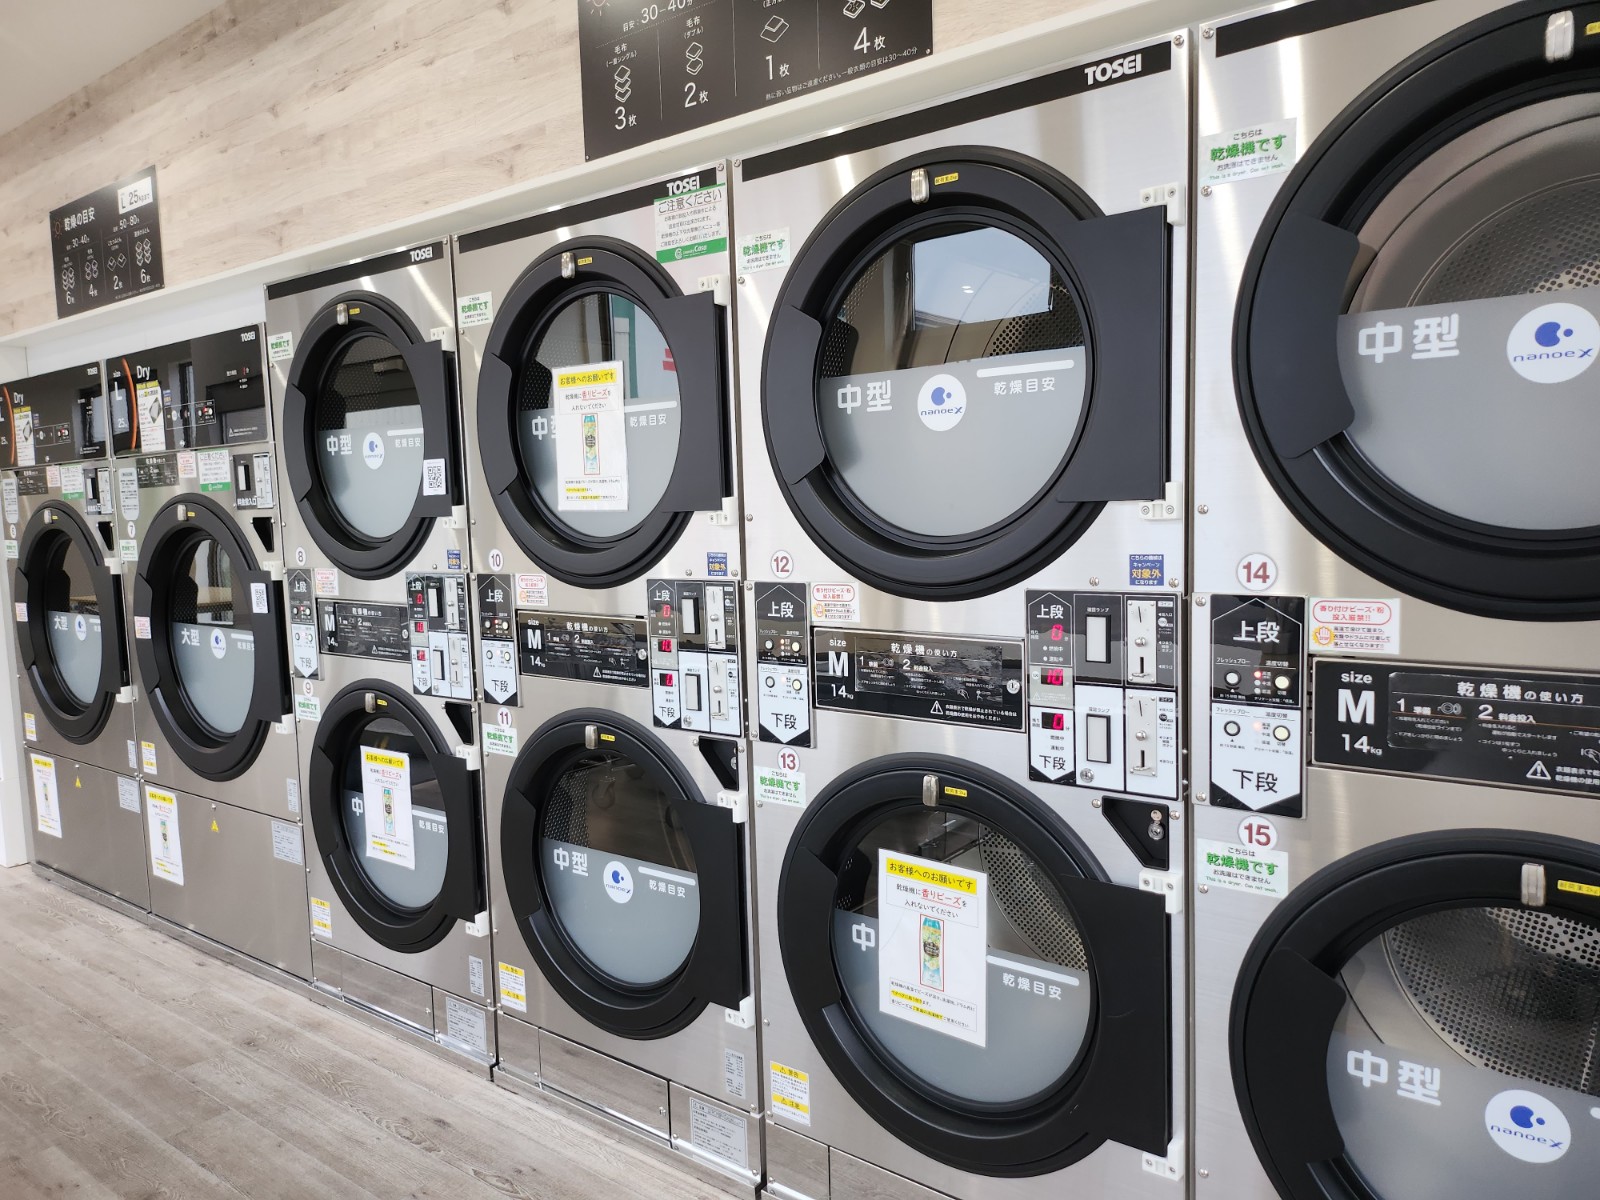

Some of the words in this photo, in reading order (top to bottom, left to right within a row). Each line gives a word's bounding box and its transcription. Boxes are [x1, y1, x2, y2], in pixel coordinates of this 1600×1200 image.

[686, 16, 700, 28] 毛布
[854, 26, 886, 54] 4枚
[614, 43, 628, 55] 毛布
[765, 55, 790, 81] 1枚
[1084, 53, 1142, 86] TOSEI
[684, 82, 709, 108] 2枚
[614, 106, 637, 130] 3枚
[1233, 129, 1262, 140] こちらは
[1210, 134, 1287, 162] 乾燥機です
[666, 176, 700, 196] TOSEI
[659, 189, 722, 214] ご注意ください
[64, 206, 96, 231] 乾燥の目安
[410, 246, 432, 262] TOSEI
[743, 239, 786, 257] 乾燥機です
[240, 331, 256, 342] TOSEI
[1358, 313, 1460, 364] 中型
[136, 366, 150, 380] Dry
[560, 372, 614, 386] お客様へのお願いです
[994, 377, 1056, 396] 乾燥目安
[14, 392, 24, 406] Dry
[837, 380, 892, 415] 中型
[630, 413, 666, 428] 乾燥目安
[326, 435, 352, 456] 中型
[129, 524, 134, 534] 7
[298, 551, 304, 562] 8
[491, 553, 501, 568] 10
[773, 556, 790, 574] 12
[1132, 568, 1162, 579] 対象外
[1242, 562, 1270, 584] 14
[294, 581, 307, 592] 上段
[486, 589, 504, 602] 上段
[654, 590, 670, 602] 上段
[768, 601, 794, 618] 上段
[1036, 604, 1064, 620] 上段
[54, 615, 69, 632] 大型
[324, 614, 336, 632] M
[528, 618, 540, 626] size
[181, 626, 200, 647] 大型
[527, 628, 542, 650] M
[1052, 624, 1064, 640] 0
[1233, 621, 1280, 644] 上段
[829, 638, 847, 647] size
[890, 642, 958, 658] 乾燥機の使い方
[300, 656, 312, 668] 下段
[828, 650, 849, 678] M
[902, 658, 910, 670] 2
[1047, 668, 1064, 685] 10
[1340, 671, 1373, 684] size
[305, 682, 312, 693] 9
[492, 680, 509, 693] 下段
[831, 684, 854, 700] 14kg
[1456, 682, 1584, 704] 乾燥機の使い方
[659, 706, 676, 718] 下段
[1338, 688, 1376, 725] M
[1397, 698, 1406, 712] 1
[500, 710, 510, 725] 11
[772, 712, 798, 730] 下段
[1478, 704, 1494, 720] 2
[1498, 713, 1536, 724] 料金投入
[1341, 734, 1382, 756] 14kg
[780, 752, 796, 770] 13
[1039, 754, 1066, 770] 下段
[760, 776, 800, 791] 乾燥機です
[1232, 768, 1278, 794] 下段
[418, 820, 444, 834] 乾燥目安
[1244, 822, 1272, 847] 15
[1227, 846, 1256, 857] こちらは
[554, 847, 588, 878] 中型
[1206, 852, 1278, 876] 乾燥機です
[889, 862, 974, 890] お客様へのお願いです
[649, 879, 686, 898] 乾燥目安
[896, 883, 968, 908] 乾燥機に香りビーズを
[904, 900, 958, 919] 入れないでください
[1002, 972, 1062, 1000] 乾燥目安
[1347, 1050, 1442, 1106] 中型
